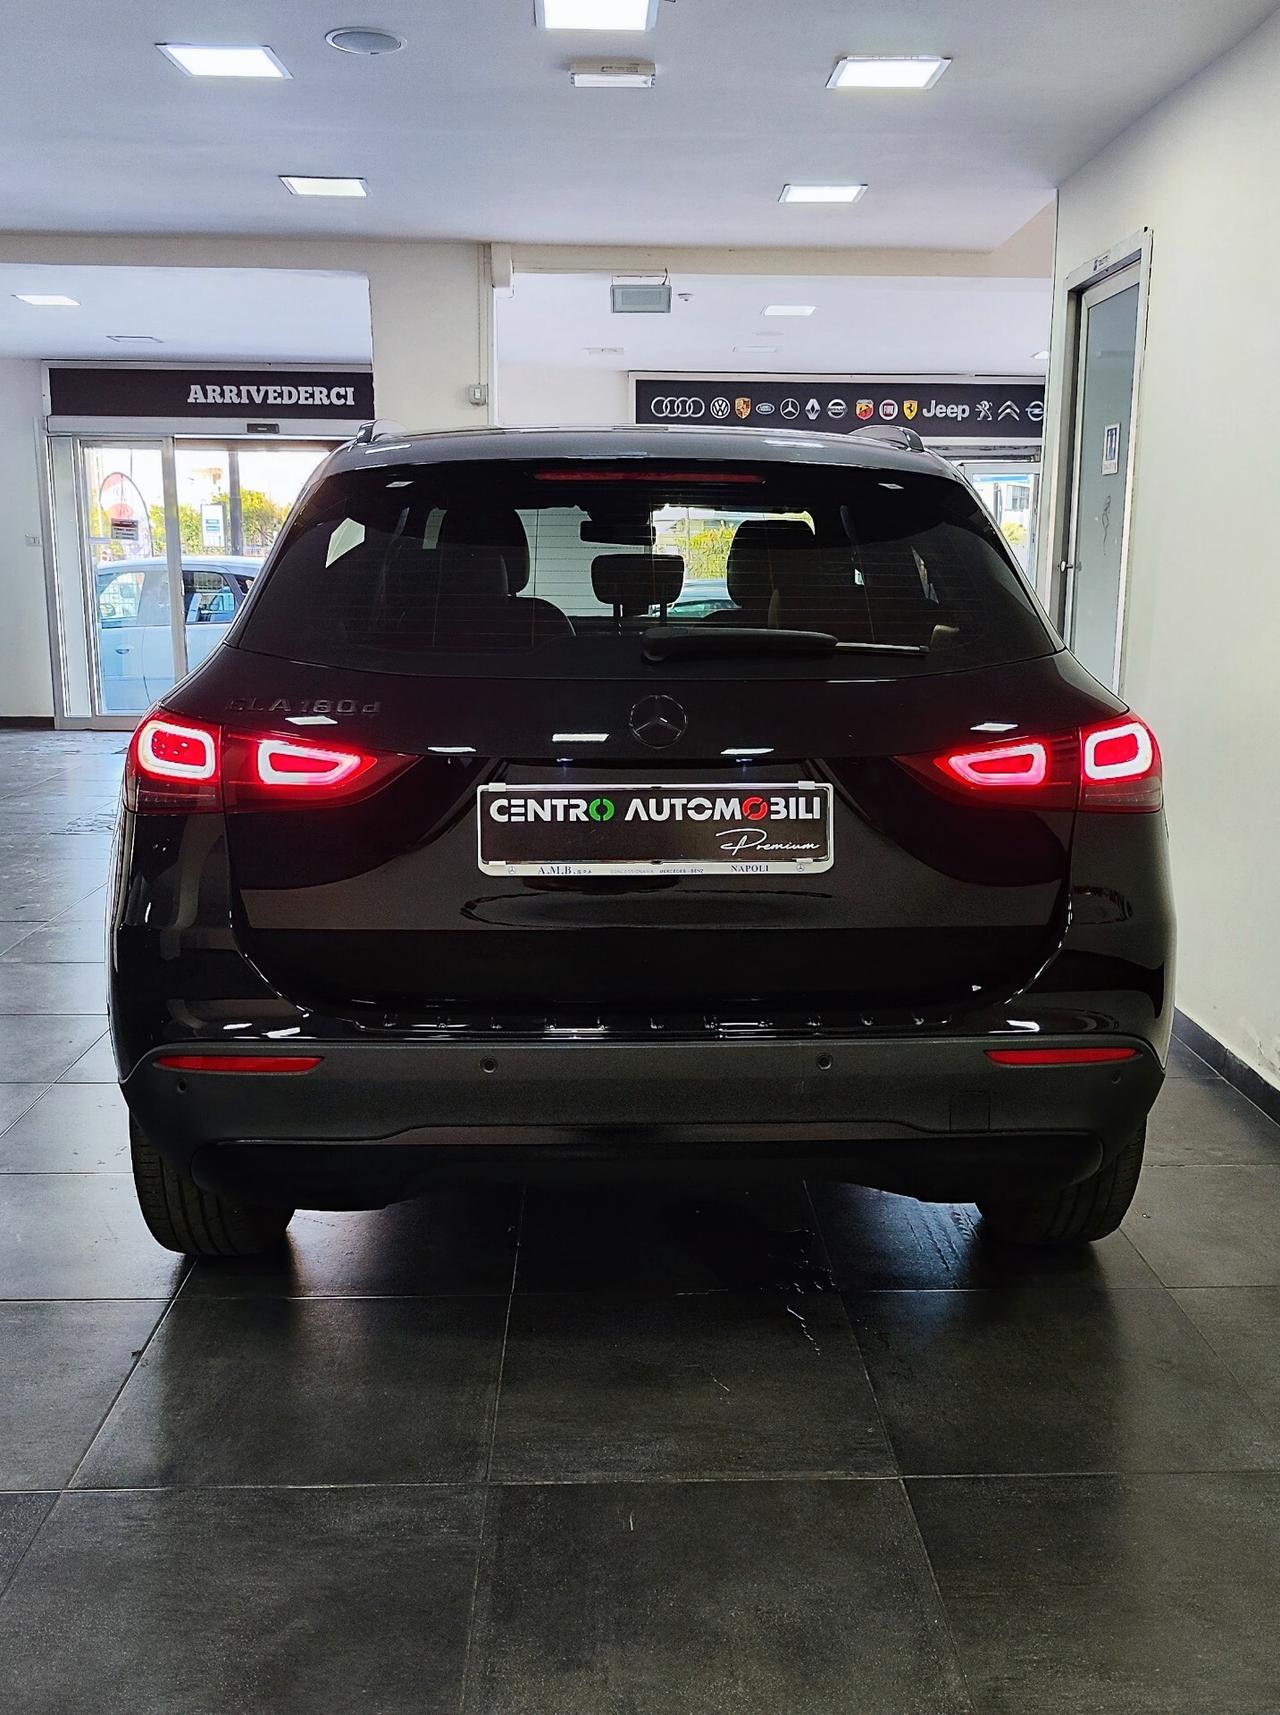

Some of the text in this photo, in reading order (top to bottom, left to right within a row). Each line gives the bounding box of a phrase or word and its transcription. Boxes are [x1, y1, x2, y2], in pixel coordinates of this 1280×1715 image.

[187, 384, 355, 406] ARRIVEDERCI
[922, 399, 970, 422] Jeep
[489, 796, 821, 823] CENTRO AUTOMOBILI
[715, 828, 820, 856] Premium
[731, 864, 769, 873] NAPOLI
